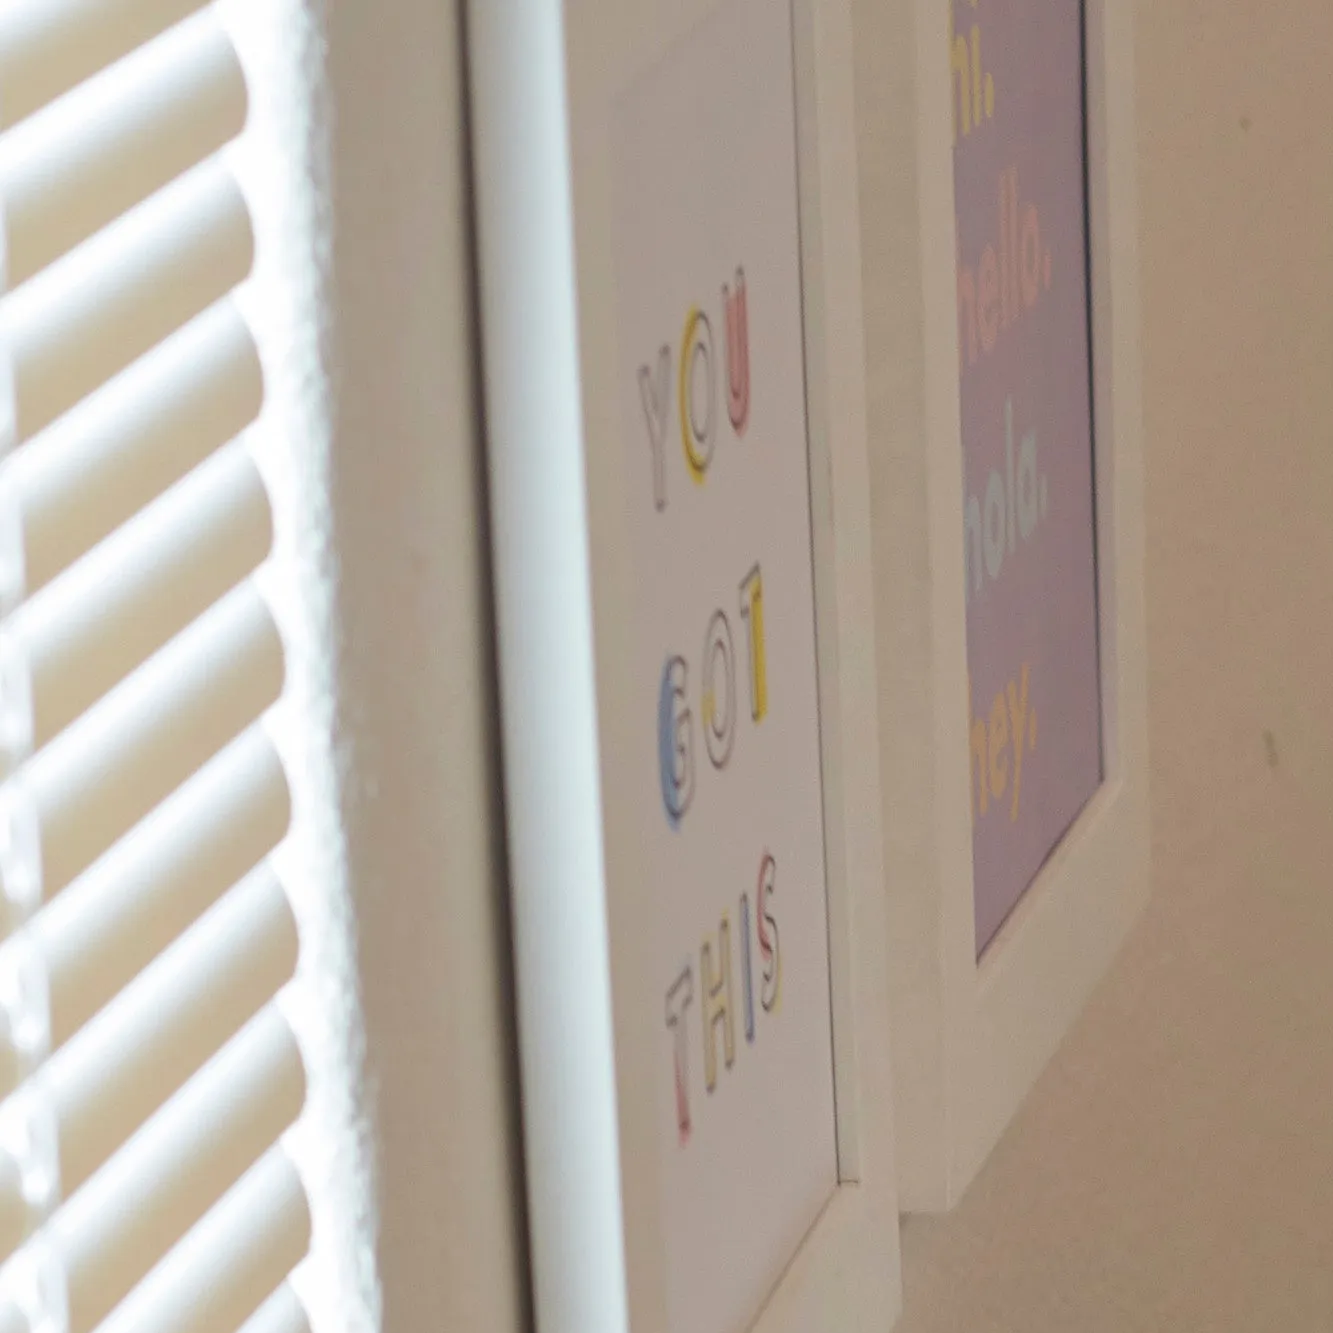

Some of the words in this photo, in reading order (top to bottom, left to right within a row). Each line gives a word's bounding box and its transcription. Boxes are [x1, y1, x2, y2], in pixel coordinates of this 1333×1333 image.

[637, 264, 750, 514] YOU
[658, 562, 768, 832] GOT
[665, 848, 781, 1146] THIS
